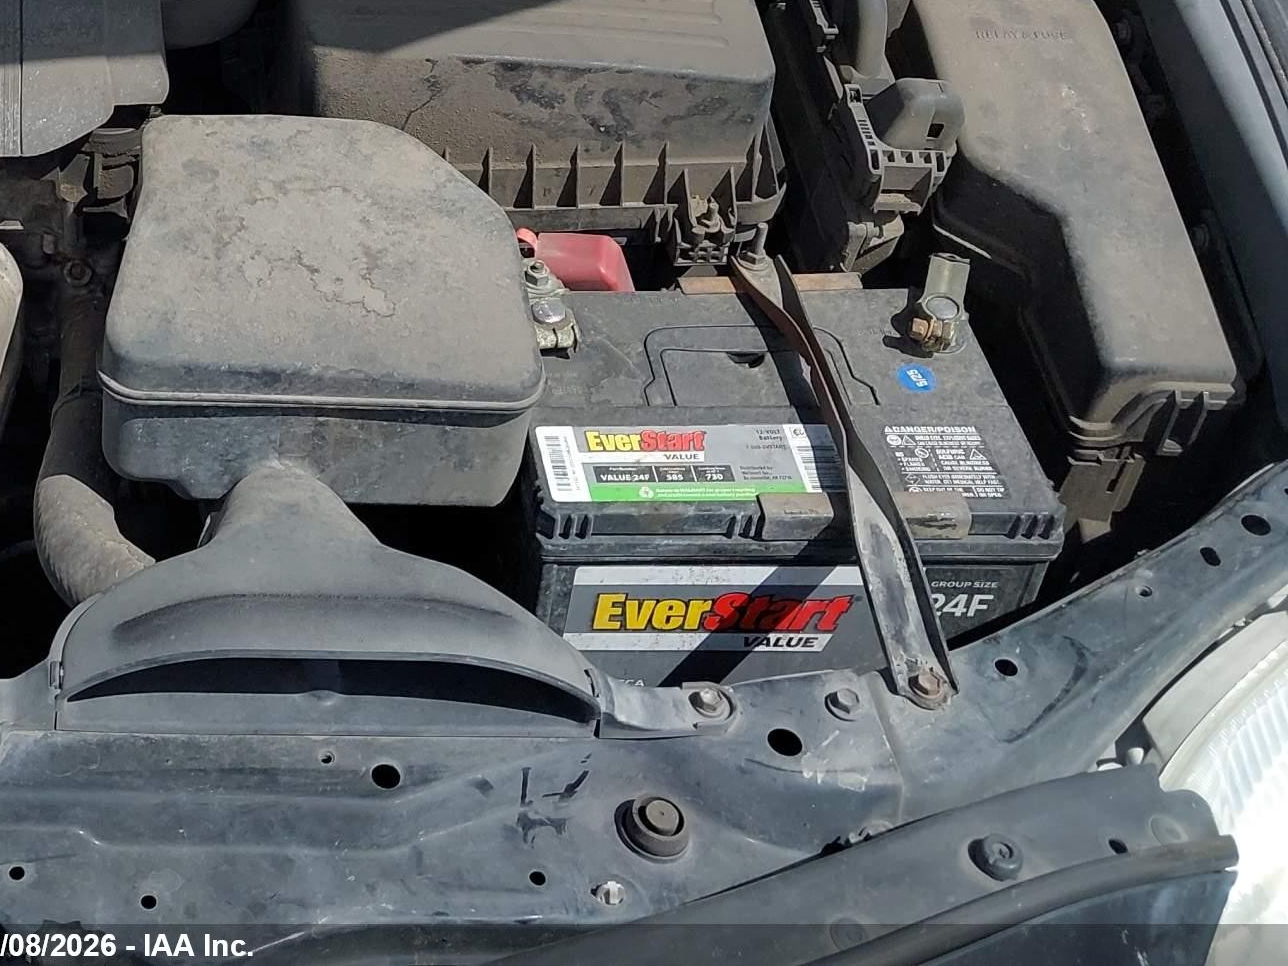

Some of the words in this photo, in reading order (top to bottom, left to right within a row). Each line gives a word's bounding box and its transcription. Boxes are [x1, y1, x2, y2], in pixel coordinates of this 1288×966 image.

[892, 425, 976, 433] DANGER/POISON
[584, 430, 706, 453] EverStart
[931, 580, 972, 588] GROUP
[972, 580, 1000, 588] SIZE
[592, 592, 855, 634] EverStart
[931, 593, 995, 617] 24F
[744, 636, 819, 648] VALUE
